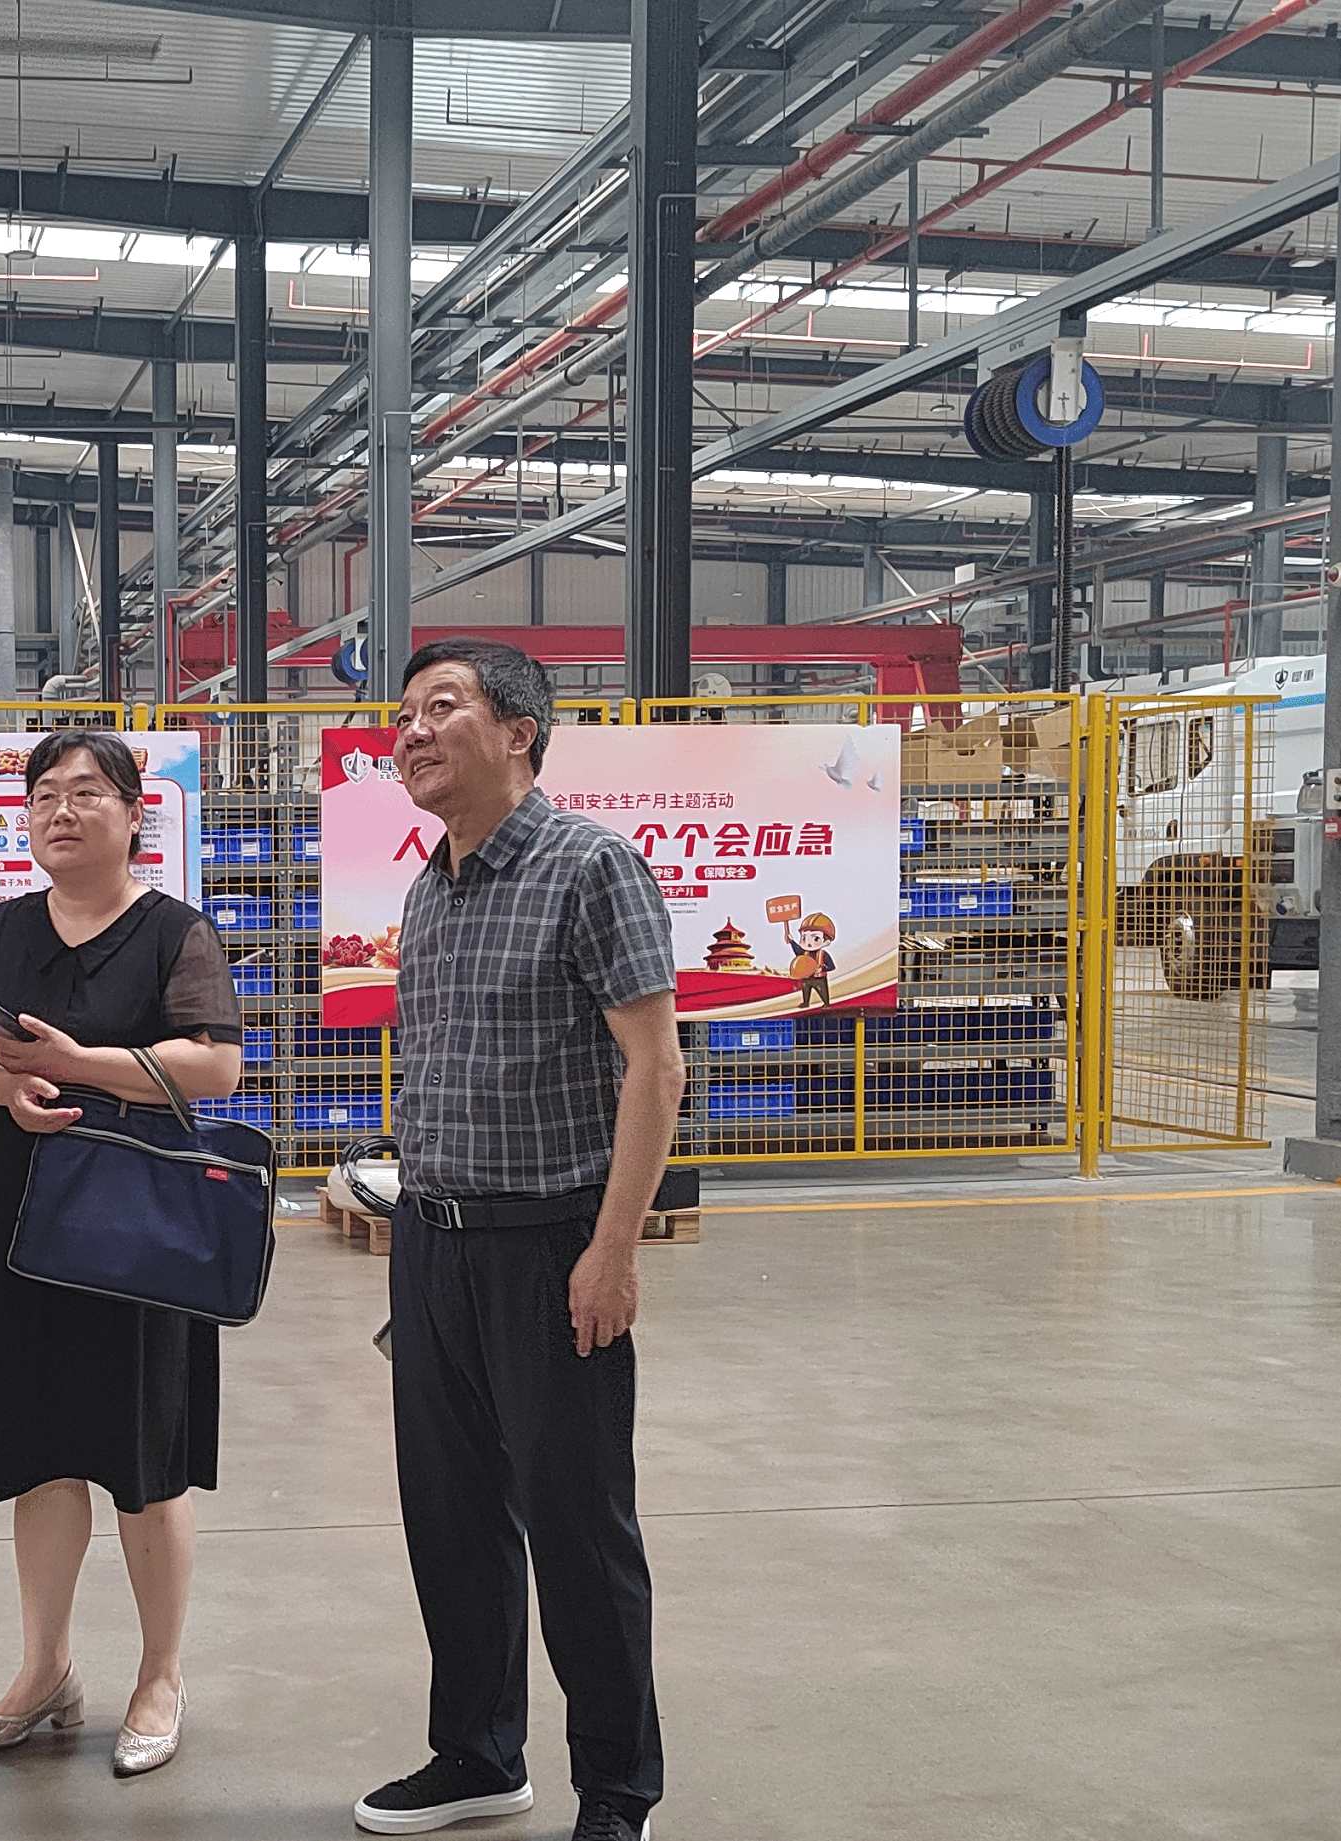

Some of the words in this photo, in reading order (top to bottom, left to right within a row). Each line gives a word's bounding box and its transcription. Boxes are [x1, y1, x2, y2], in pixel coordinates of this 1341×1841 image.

[545, 792, 734, 810] 全国安全生产月主题活动
[632, 823, 834, 858] 个个会应急
[703, 867, 748, 879] 保障安全
